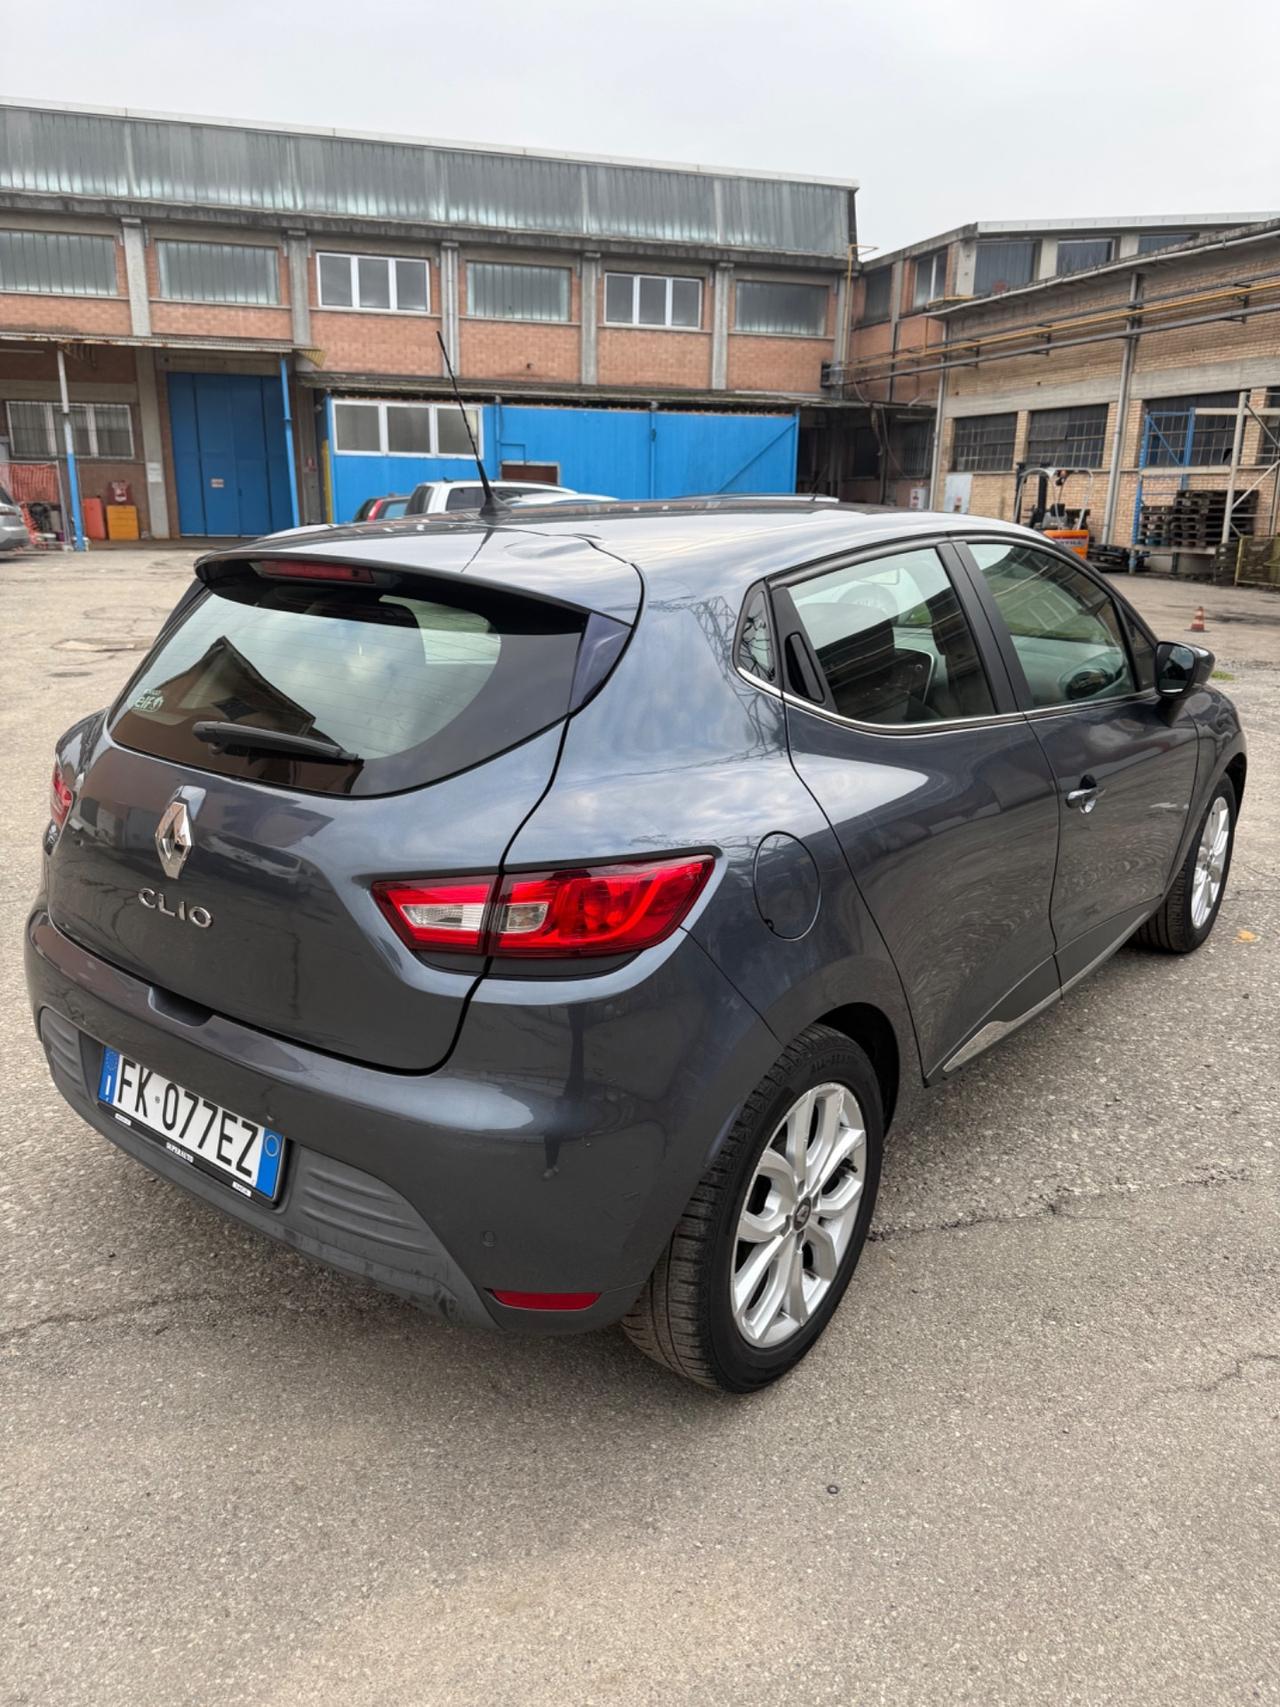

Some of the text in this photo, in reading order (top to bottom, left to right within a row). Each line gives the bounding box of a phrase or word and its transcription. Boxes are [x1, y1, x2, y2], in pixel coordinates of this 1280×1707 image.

[137, 887, 213, 928] CLIO
[117, 1057, 259, 1179] FK 077EZ
